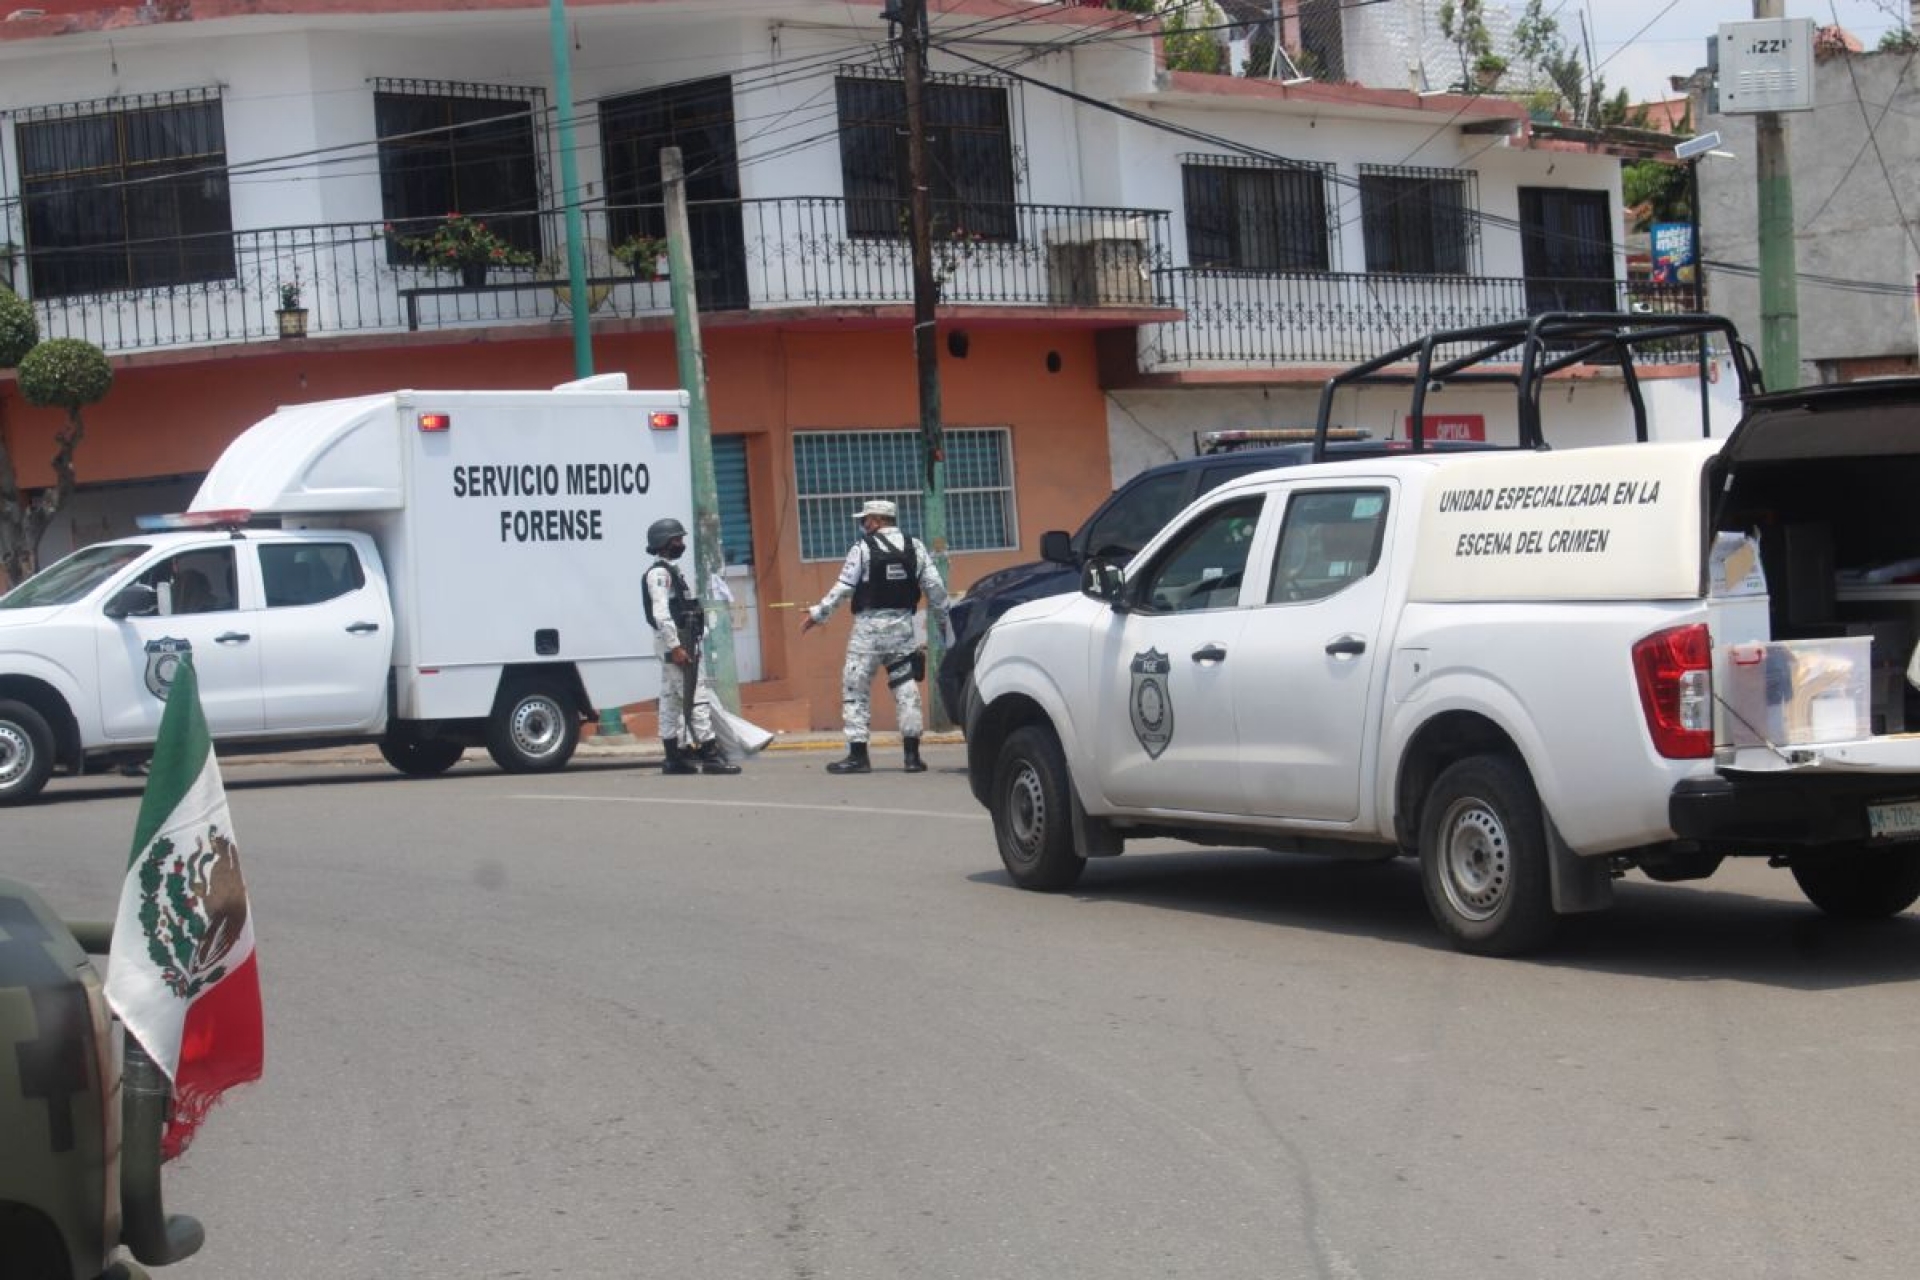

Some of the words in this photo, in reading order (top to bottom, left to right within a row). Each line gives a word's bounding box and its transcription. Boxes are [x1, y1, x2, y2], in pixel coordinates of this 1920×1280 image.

[453, 464, 559, 497] SERVICIO
[566, 463, 650, 495] MEDICO
[1439, 488, 1494, 512] UNIDAD
[1494, 482, 1610, 510] ESPECIALIZADA
[1612, 481, 1638, 505] EN
[1638, 480, 1661, 504] LA
[500, 509, 603, 542] FORENSE
[1456, 532, 1512, 557] ESCENA
[1515, 530, 1543, 554] DEL
[1548, 529, 1610, 552] CRIMEN
